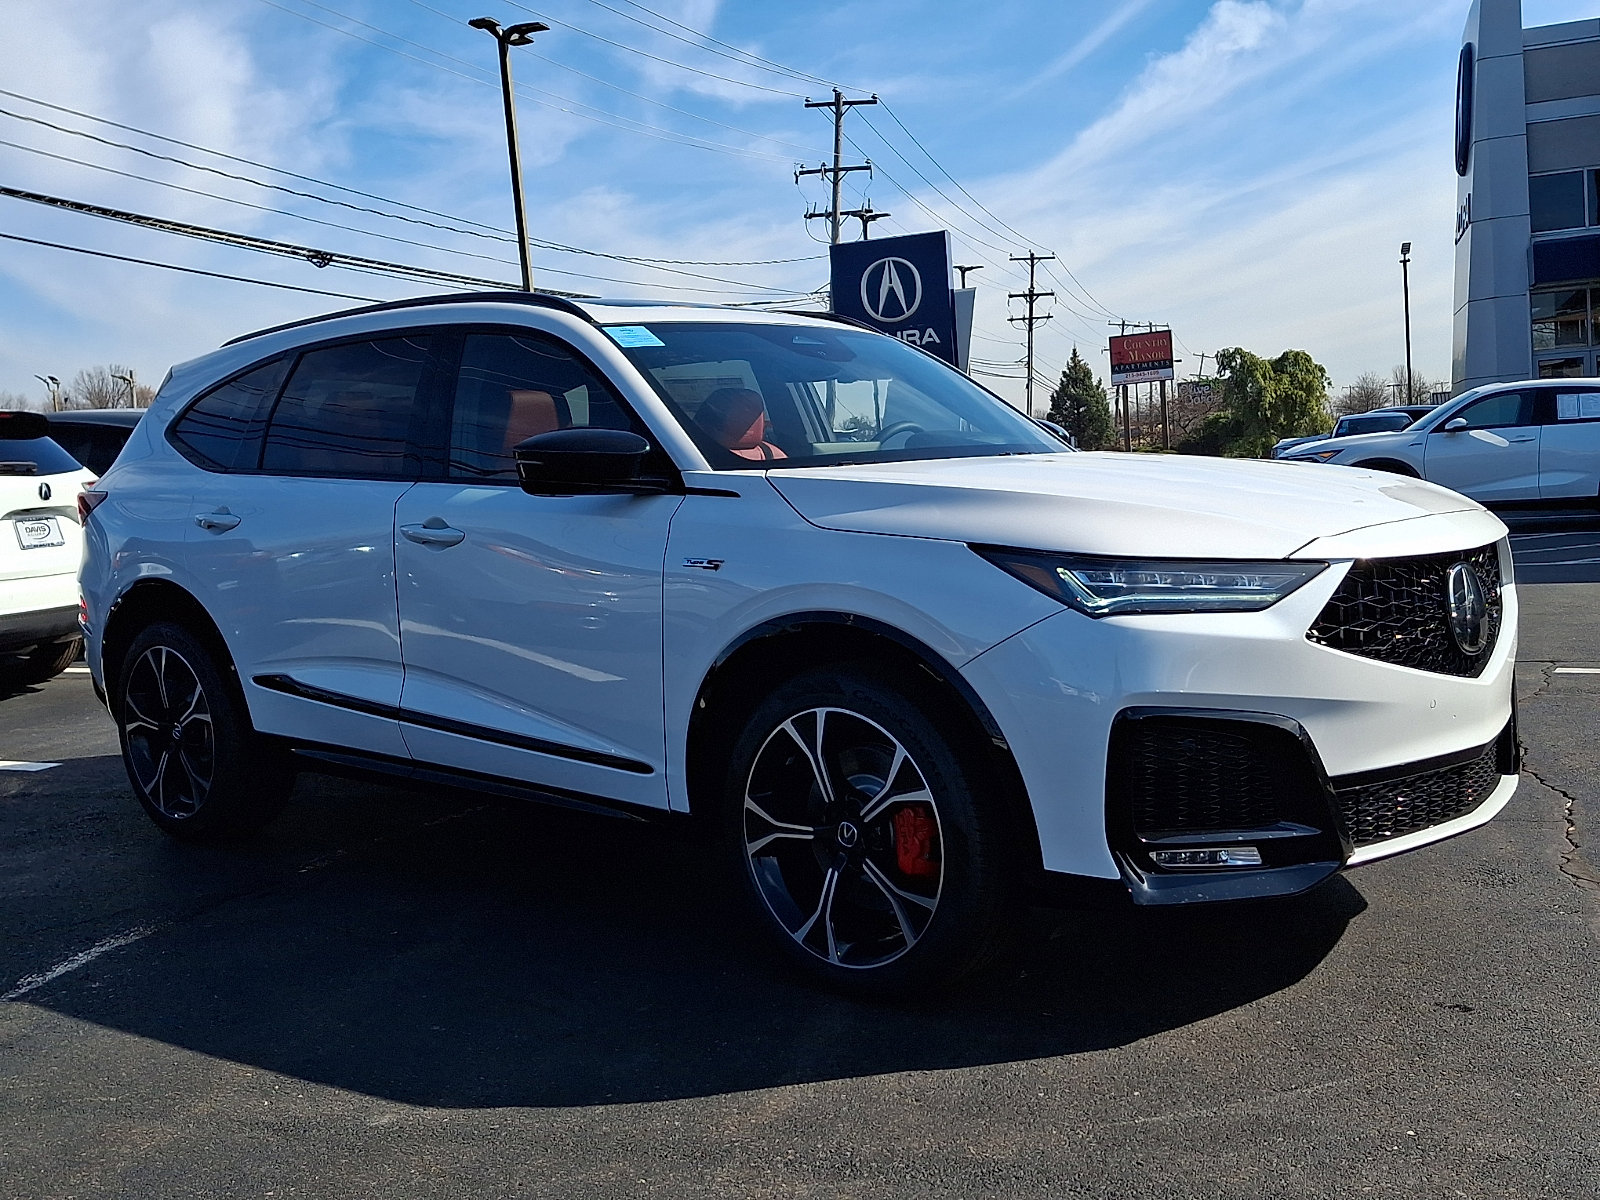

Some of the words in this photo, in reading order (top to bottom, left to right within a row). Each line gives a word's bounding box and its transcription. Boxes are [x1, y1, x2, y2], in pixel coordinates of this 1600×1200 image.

[1123, 338, 1168, 350] COUNTRY
[1128, 350, 1165, 362] MANOR
[1114, 360, 1170, 371] APARTMENTS
[25, 525, 46, 534] DAVIS
